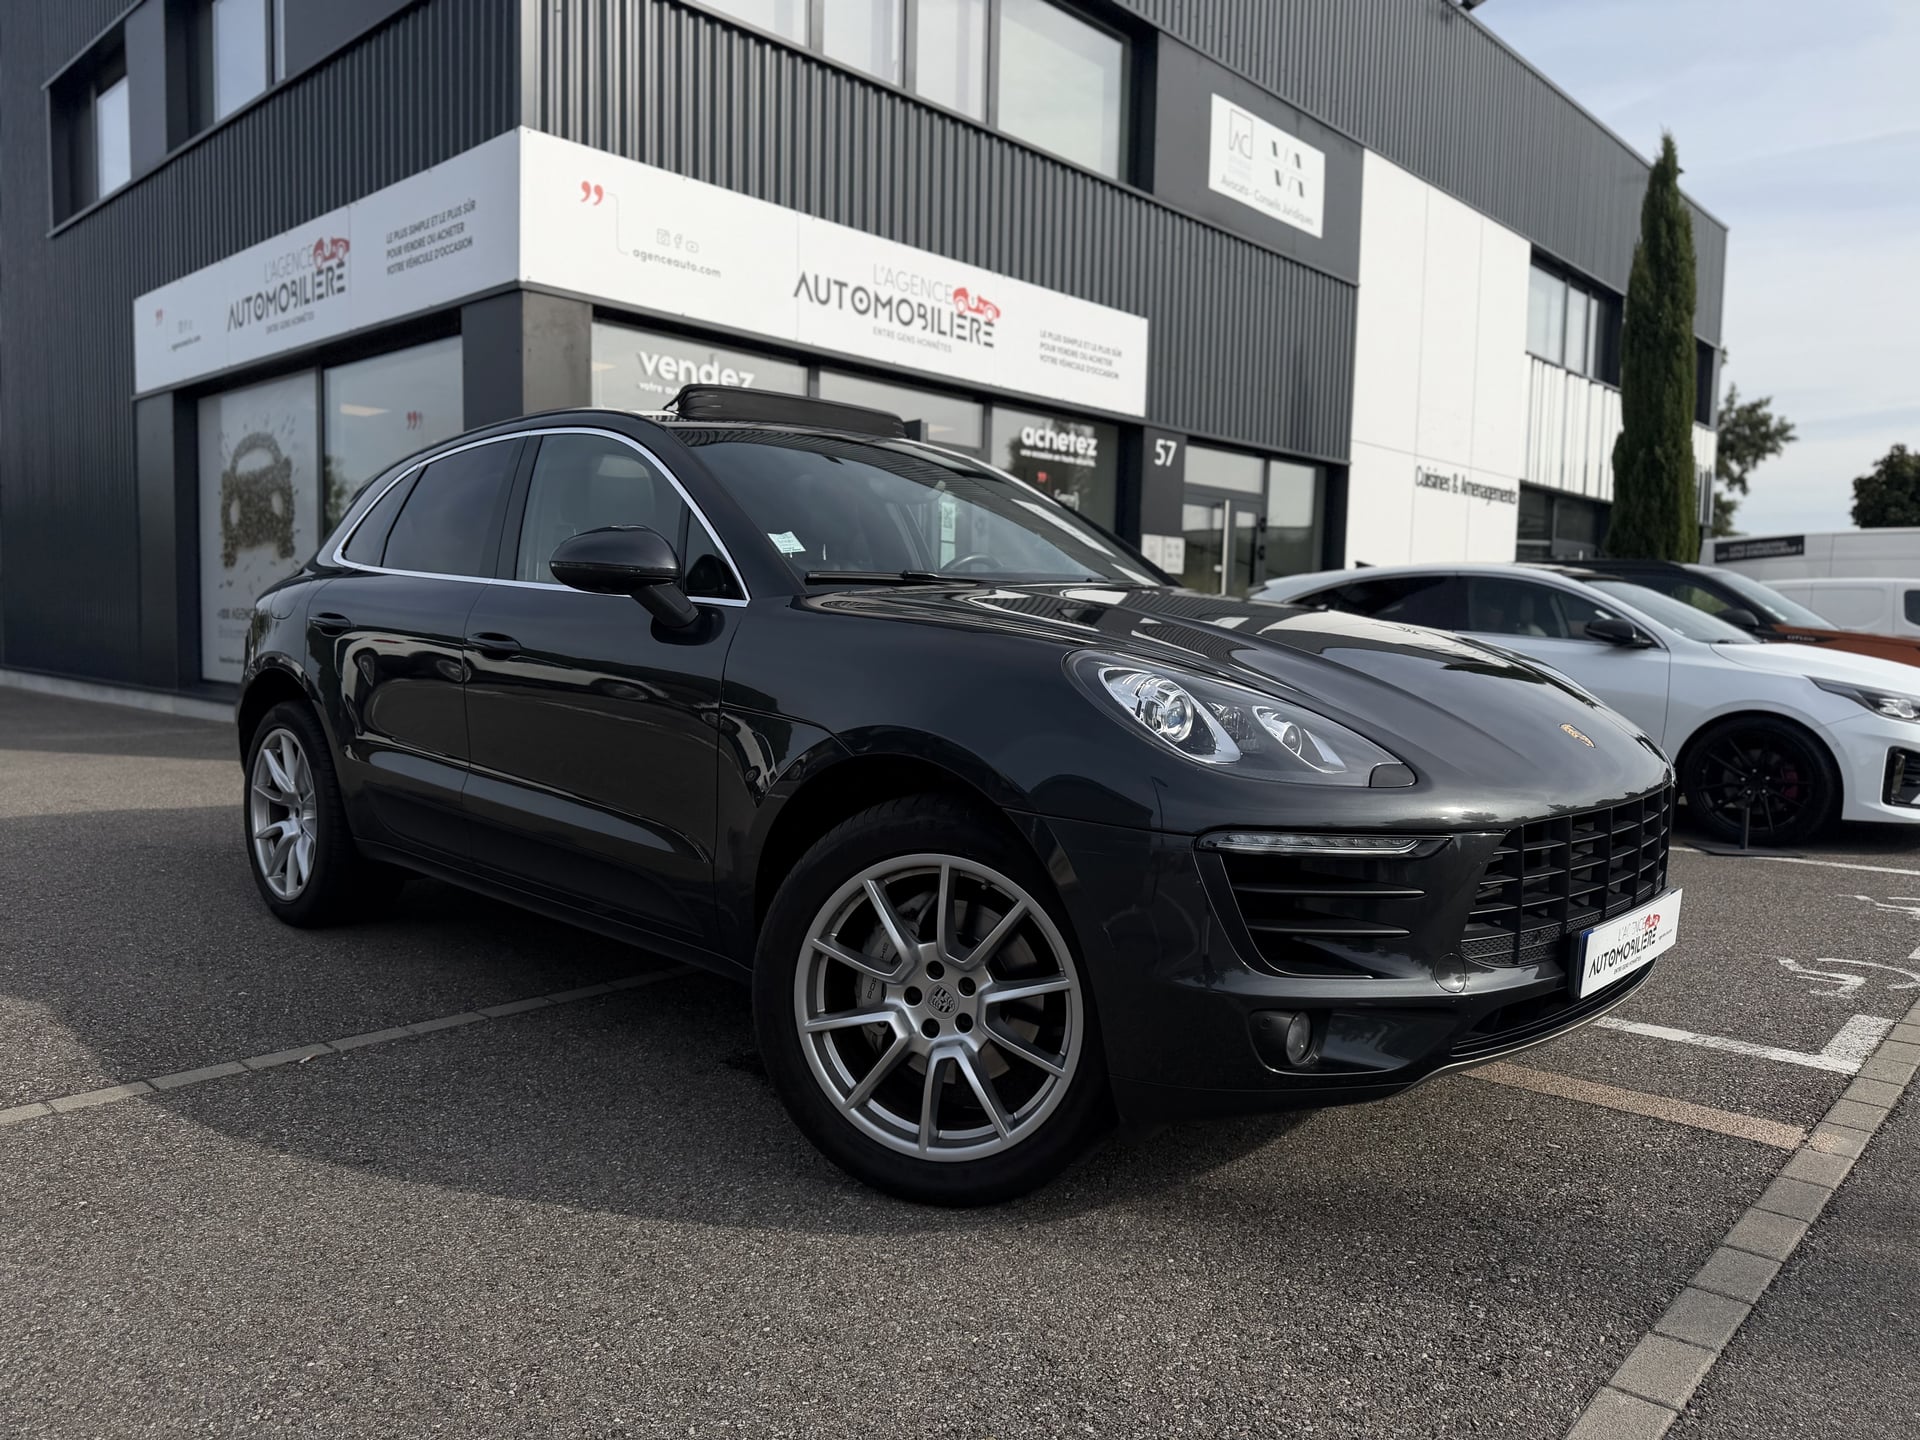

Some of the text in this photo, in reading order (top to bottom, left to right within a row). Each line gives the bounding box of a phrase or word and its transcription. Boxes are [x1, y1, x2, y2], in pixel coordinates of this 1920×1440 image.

[633, 248, 722, 279] agenceauto.com
[873, 263, 954, 305] L'AGENCE
[639, 350, 755, 388] vendez
[1021, 424, 1098, 457] achetez
[1154, 438, 1177, 467] 57
